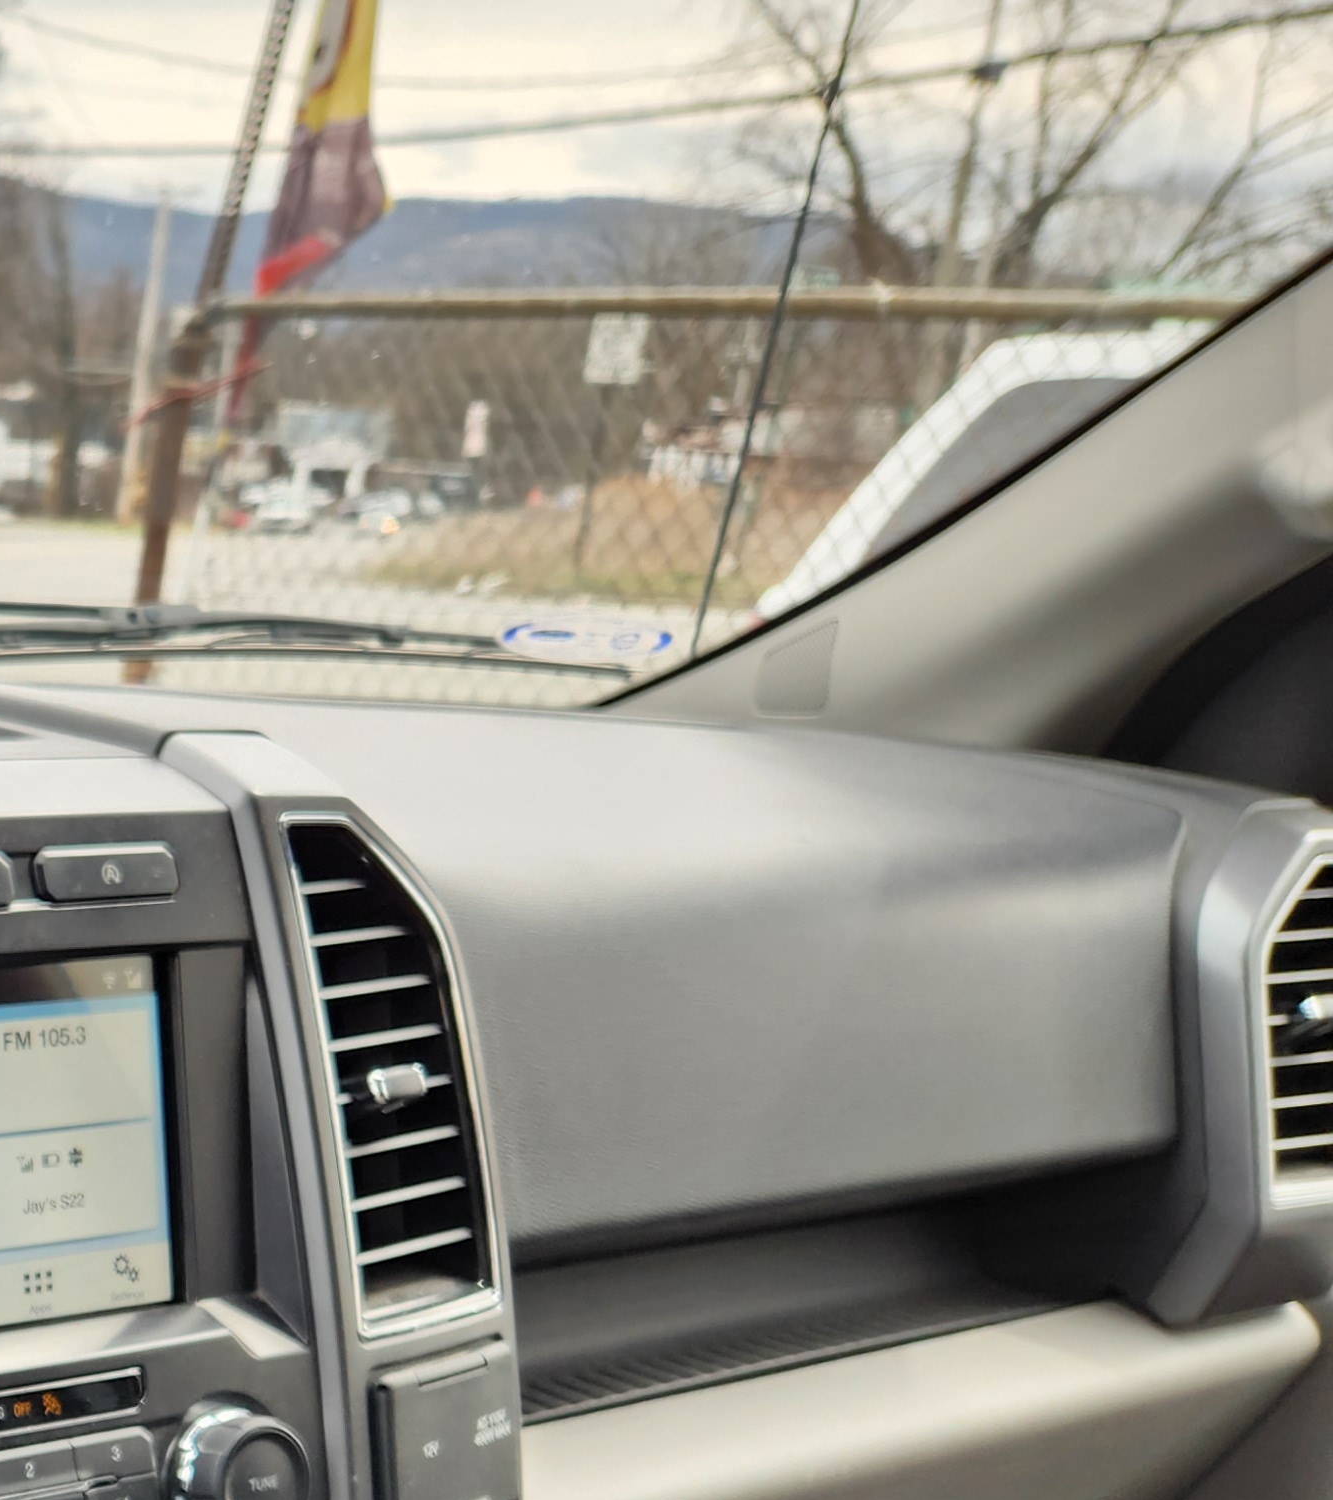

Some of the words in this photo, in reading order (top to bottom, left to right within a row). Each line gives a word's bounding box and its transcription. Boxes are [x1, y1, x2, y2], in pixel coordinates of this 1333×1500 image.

[2, 1030, 32, 1052] FM
[38, 1026, 86, 1048] 105.3
[23, 1197, 57, 1215] Jay's
[60, 1192, 86, 1210] S22
[111, 1444, 122, 1462] 3
[25, 1462, 35, 1479] 2
